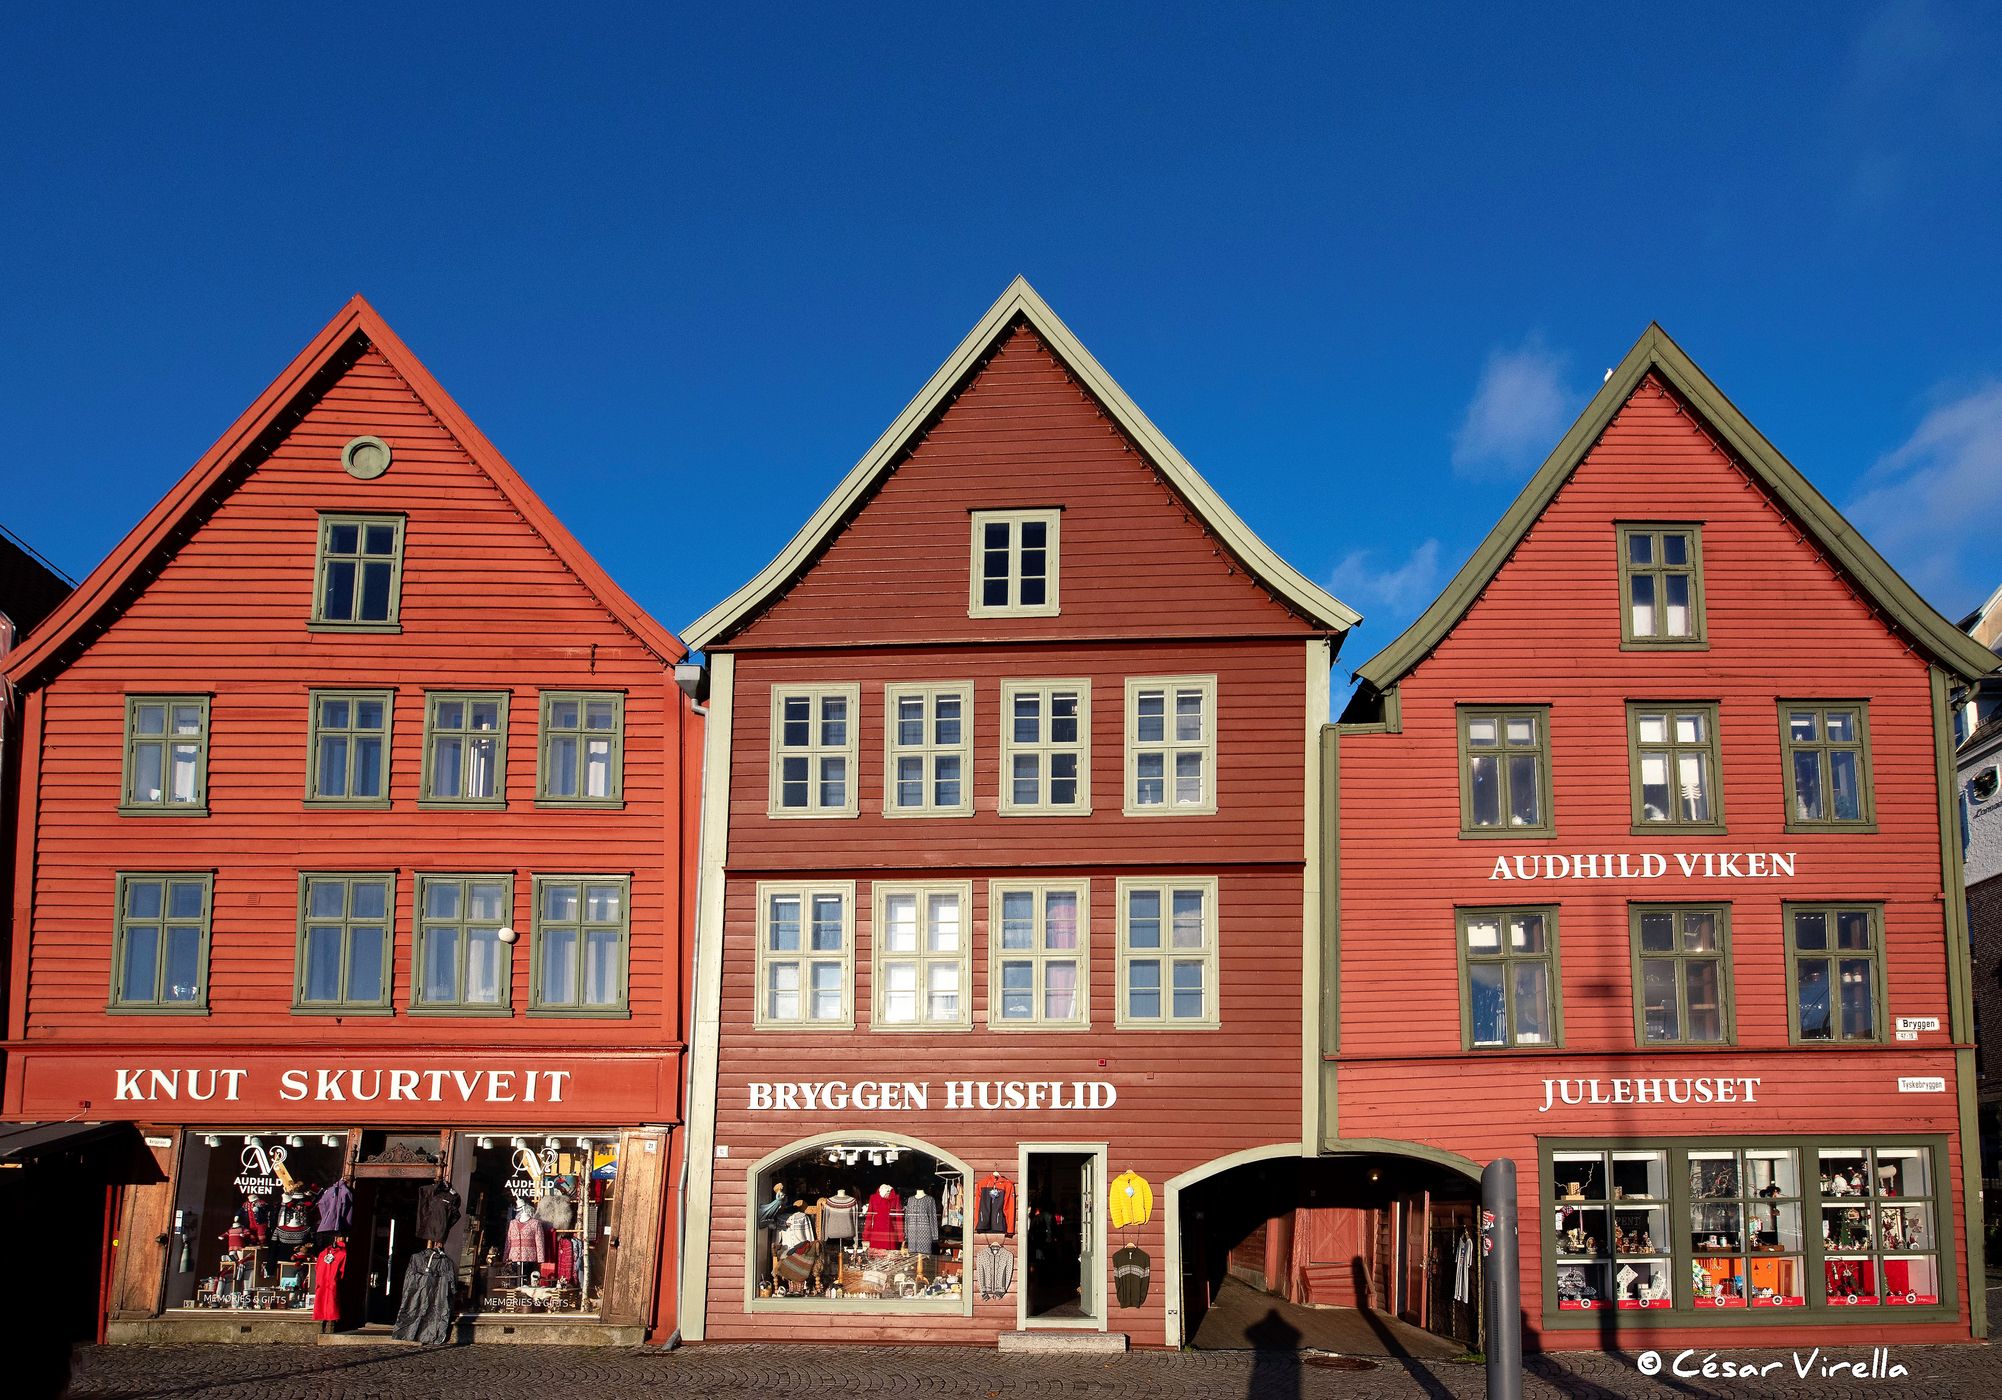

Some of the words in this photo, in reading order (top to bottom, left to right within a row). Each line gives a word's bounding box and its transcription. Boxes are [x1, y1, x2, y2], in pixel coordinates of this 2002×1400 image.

[1488, 853, 1667, 880] AUDHILD
[1673, 852, 1797, 878] VIKEN
[1902, 1019, 1935, 1030] Bryggen
[113, 1068, 248, 1101] KNUT
[279, 1069, 572, 1102] SKURTVEIT
[1901, 1079, 1943, 1091] Tyskebryggen
[747, 1080, 930, 1111] BRYGGEN
[945, 1080, 1117, 1110] HUSFLID
[1538, 1077, 1761, 1112] JULEHUSET
[233, 1176, 284, 1187] AUDHILD
[504, 1179, 555, 1189] AUDHILD
[239, 1185, 273, 1195] VIKEN
[510, 1188, 544, 1197] VIKEN
[203, 1294, 251, 1304] MEMORIES
[261, 1295, 287, 1305] GIFTS
[483, 1298, 533, 1307] MEMORIES
[542, 1299, 569, 1308] GIFTS
